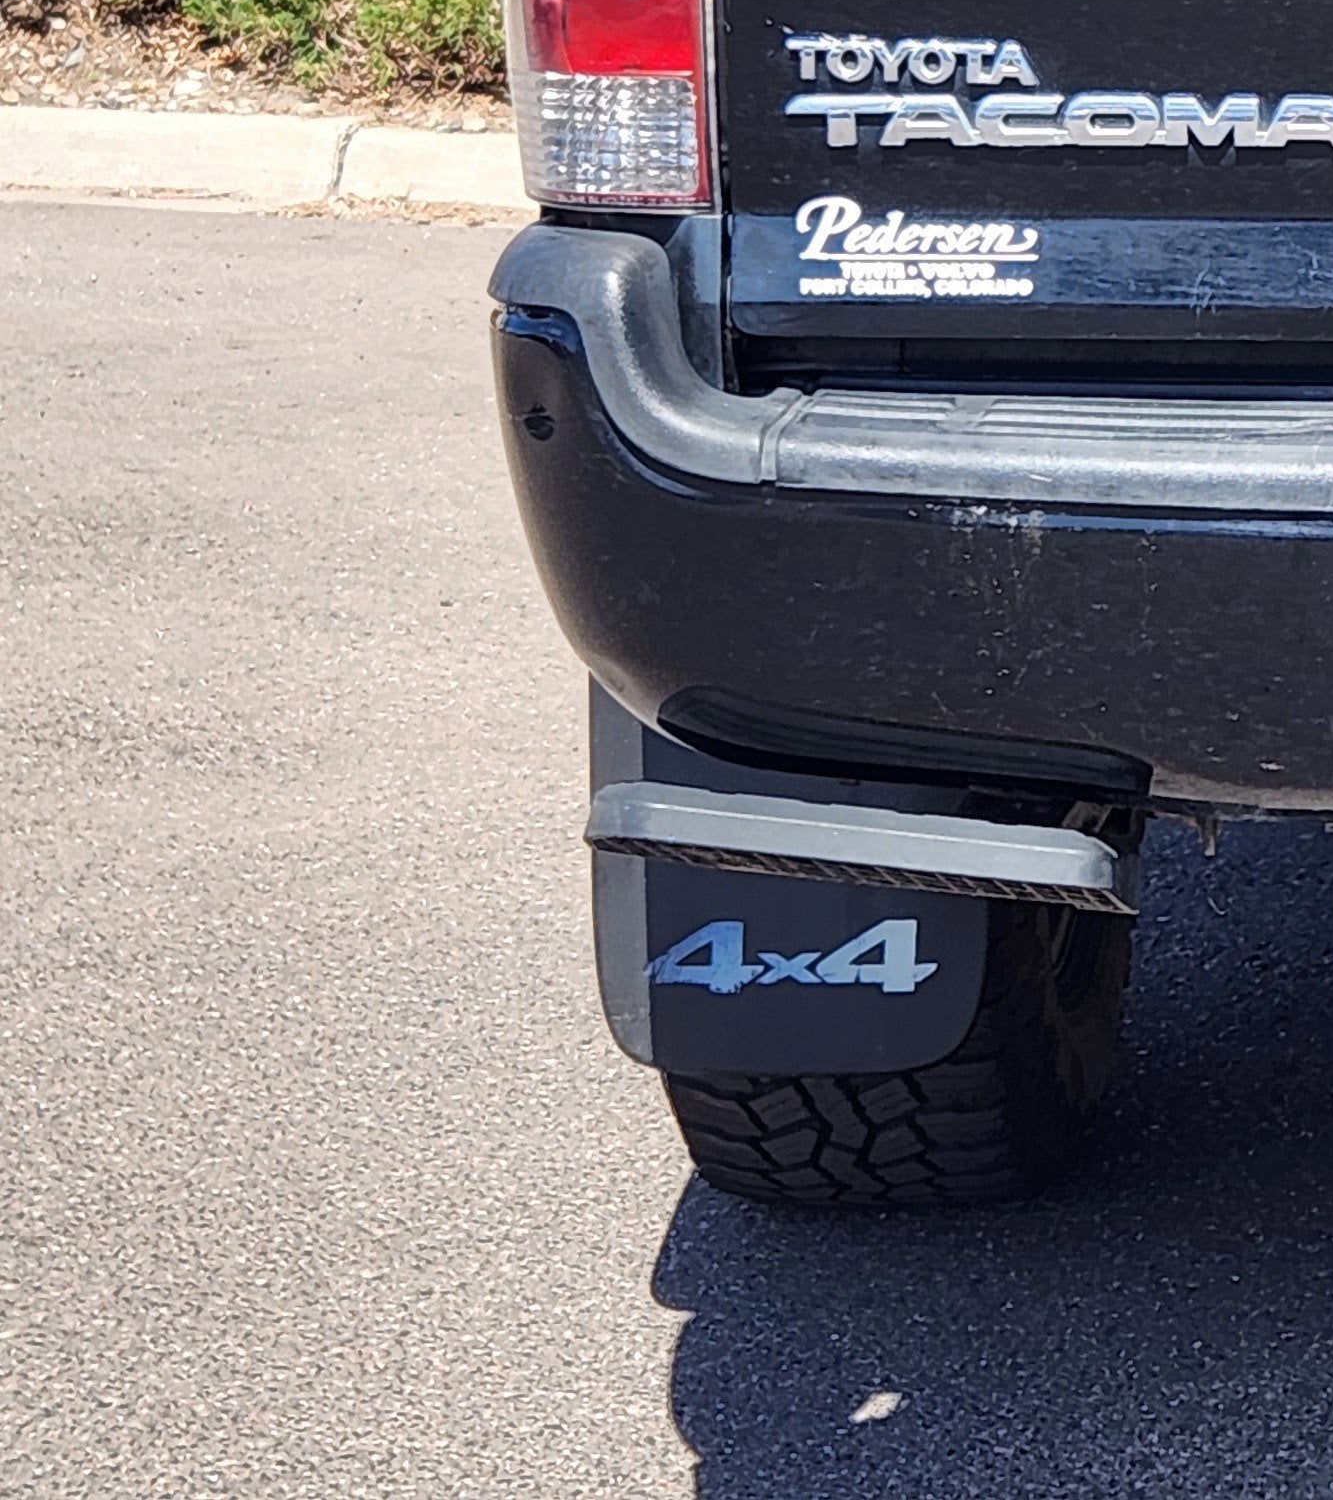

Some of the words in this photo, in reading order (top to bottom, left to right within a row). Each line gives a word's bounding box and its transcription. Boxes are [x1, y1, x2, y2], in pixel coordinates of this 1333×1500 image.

[785, 34, 1040, 86] TOYOTA
[796, 196, 1038, 260] Pedersen
[644, 919, 938, 993] 4x4
